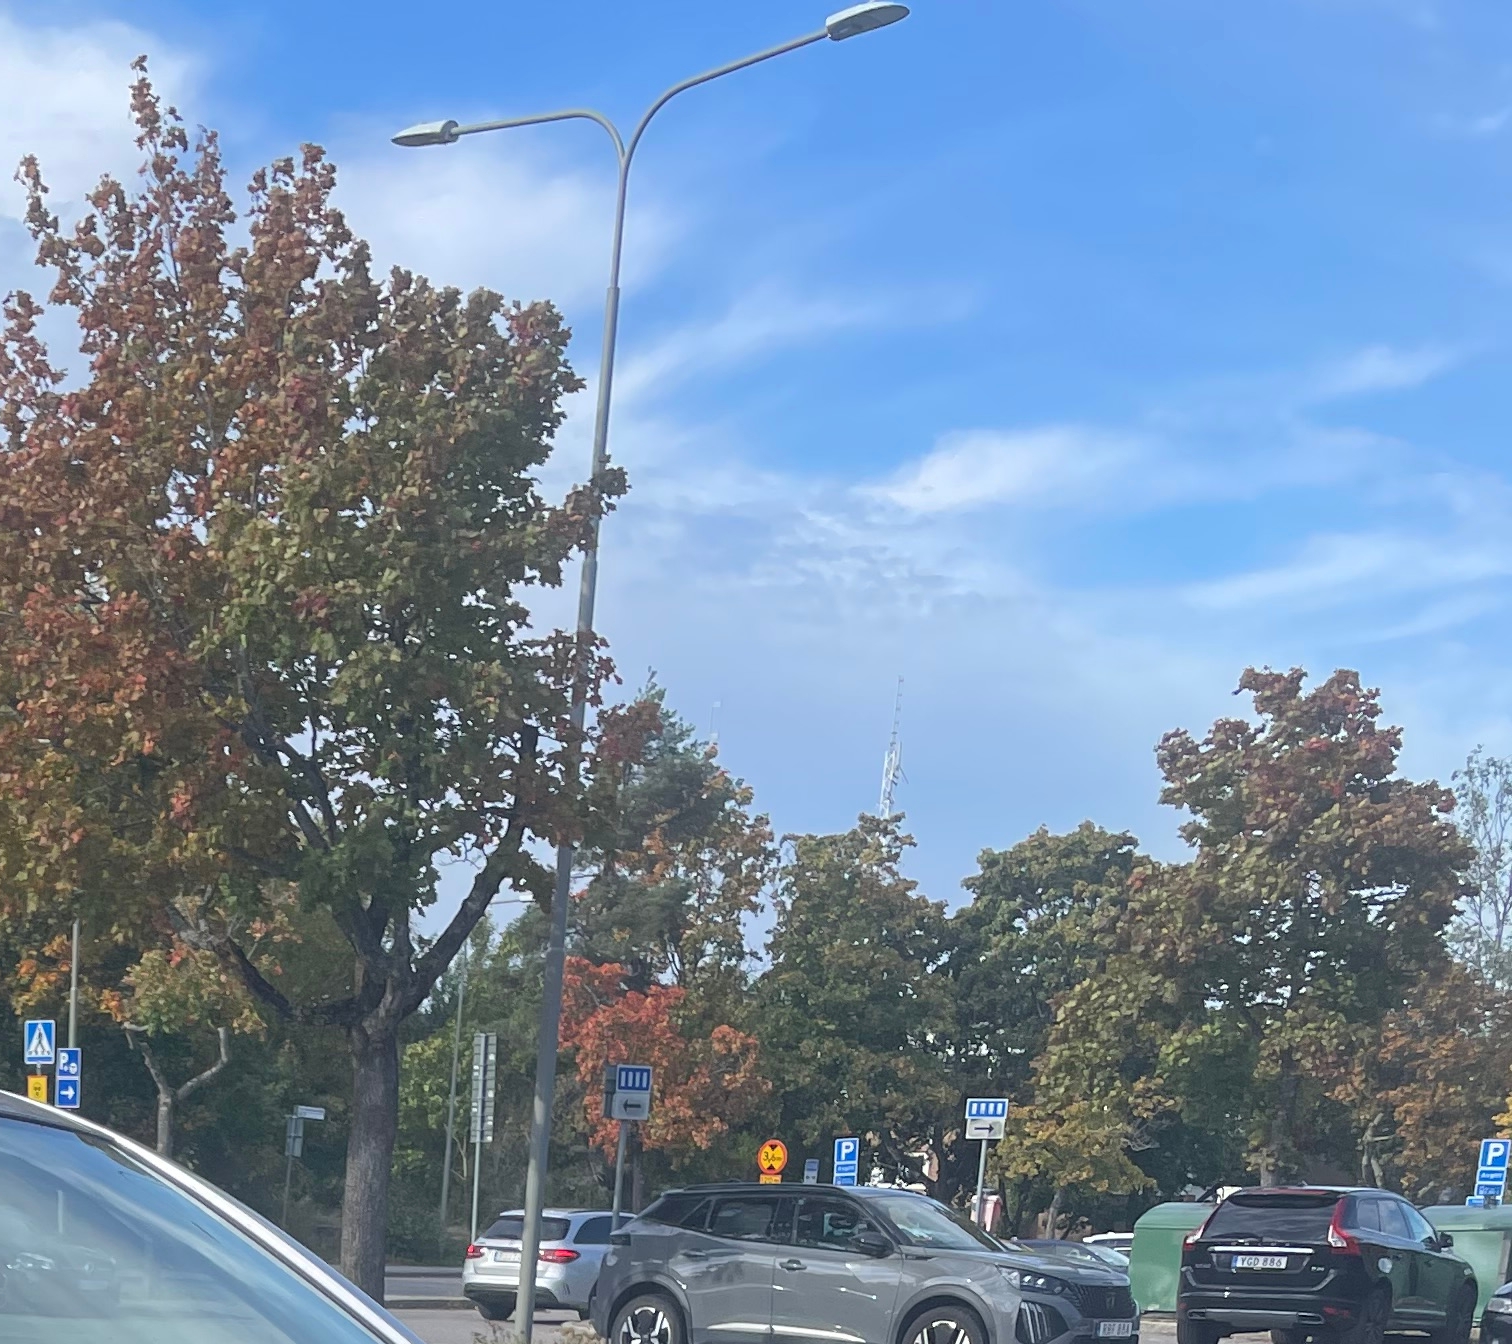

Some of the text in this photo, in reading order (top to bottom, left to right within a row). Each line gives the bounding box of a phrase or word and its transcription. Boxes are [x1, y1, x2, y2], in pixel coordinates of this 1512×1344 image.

[60, 1052, 69, 1070] P
[841, 1141, 855, 1160] P
[1487, 1142, 1505, 1166] P
[1240, 1256, 1260, 1266] YGD
